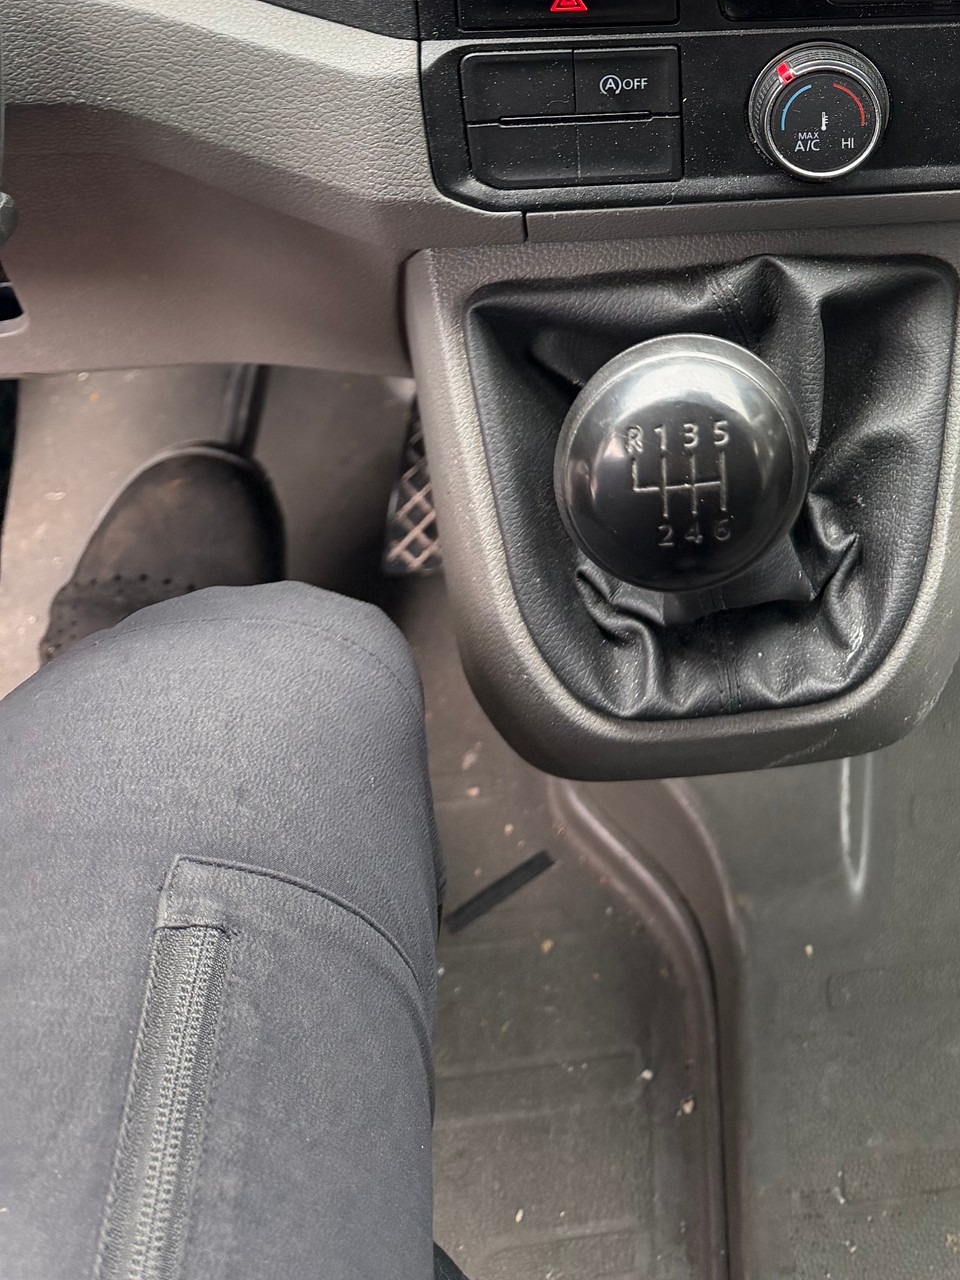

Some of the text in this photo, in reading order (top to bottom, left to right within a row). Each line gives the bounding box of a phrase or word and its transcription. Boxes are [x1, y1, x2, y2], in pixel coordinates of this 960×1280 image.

[622, 78, 648, 90] OFF
[798, 131, 820, 140] MAX
[794, 139, 821, 153] A/C
[841, 137, 855, 149] HI
[625, 420, 730, 454] R 1 3 5
[657, 518, 731, 547] 2 4 6
